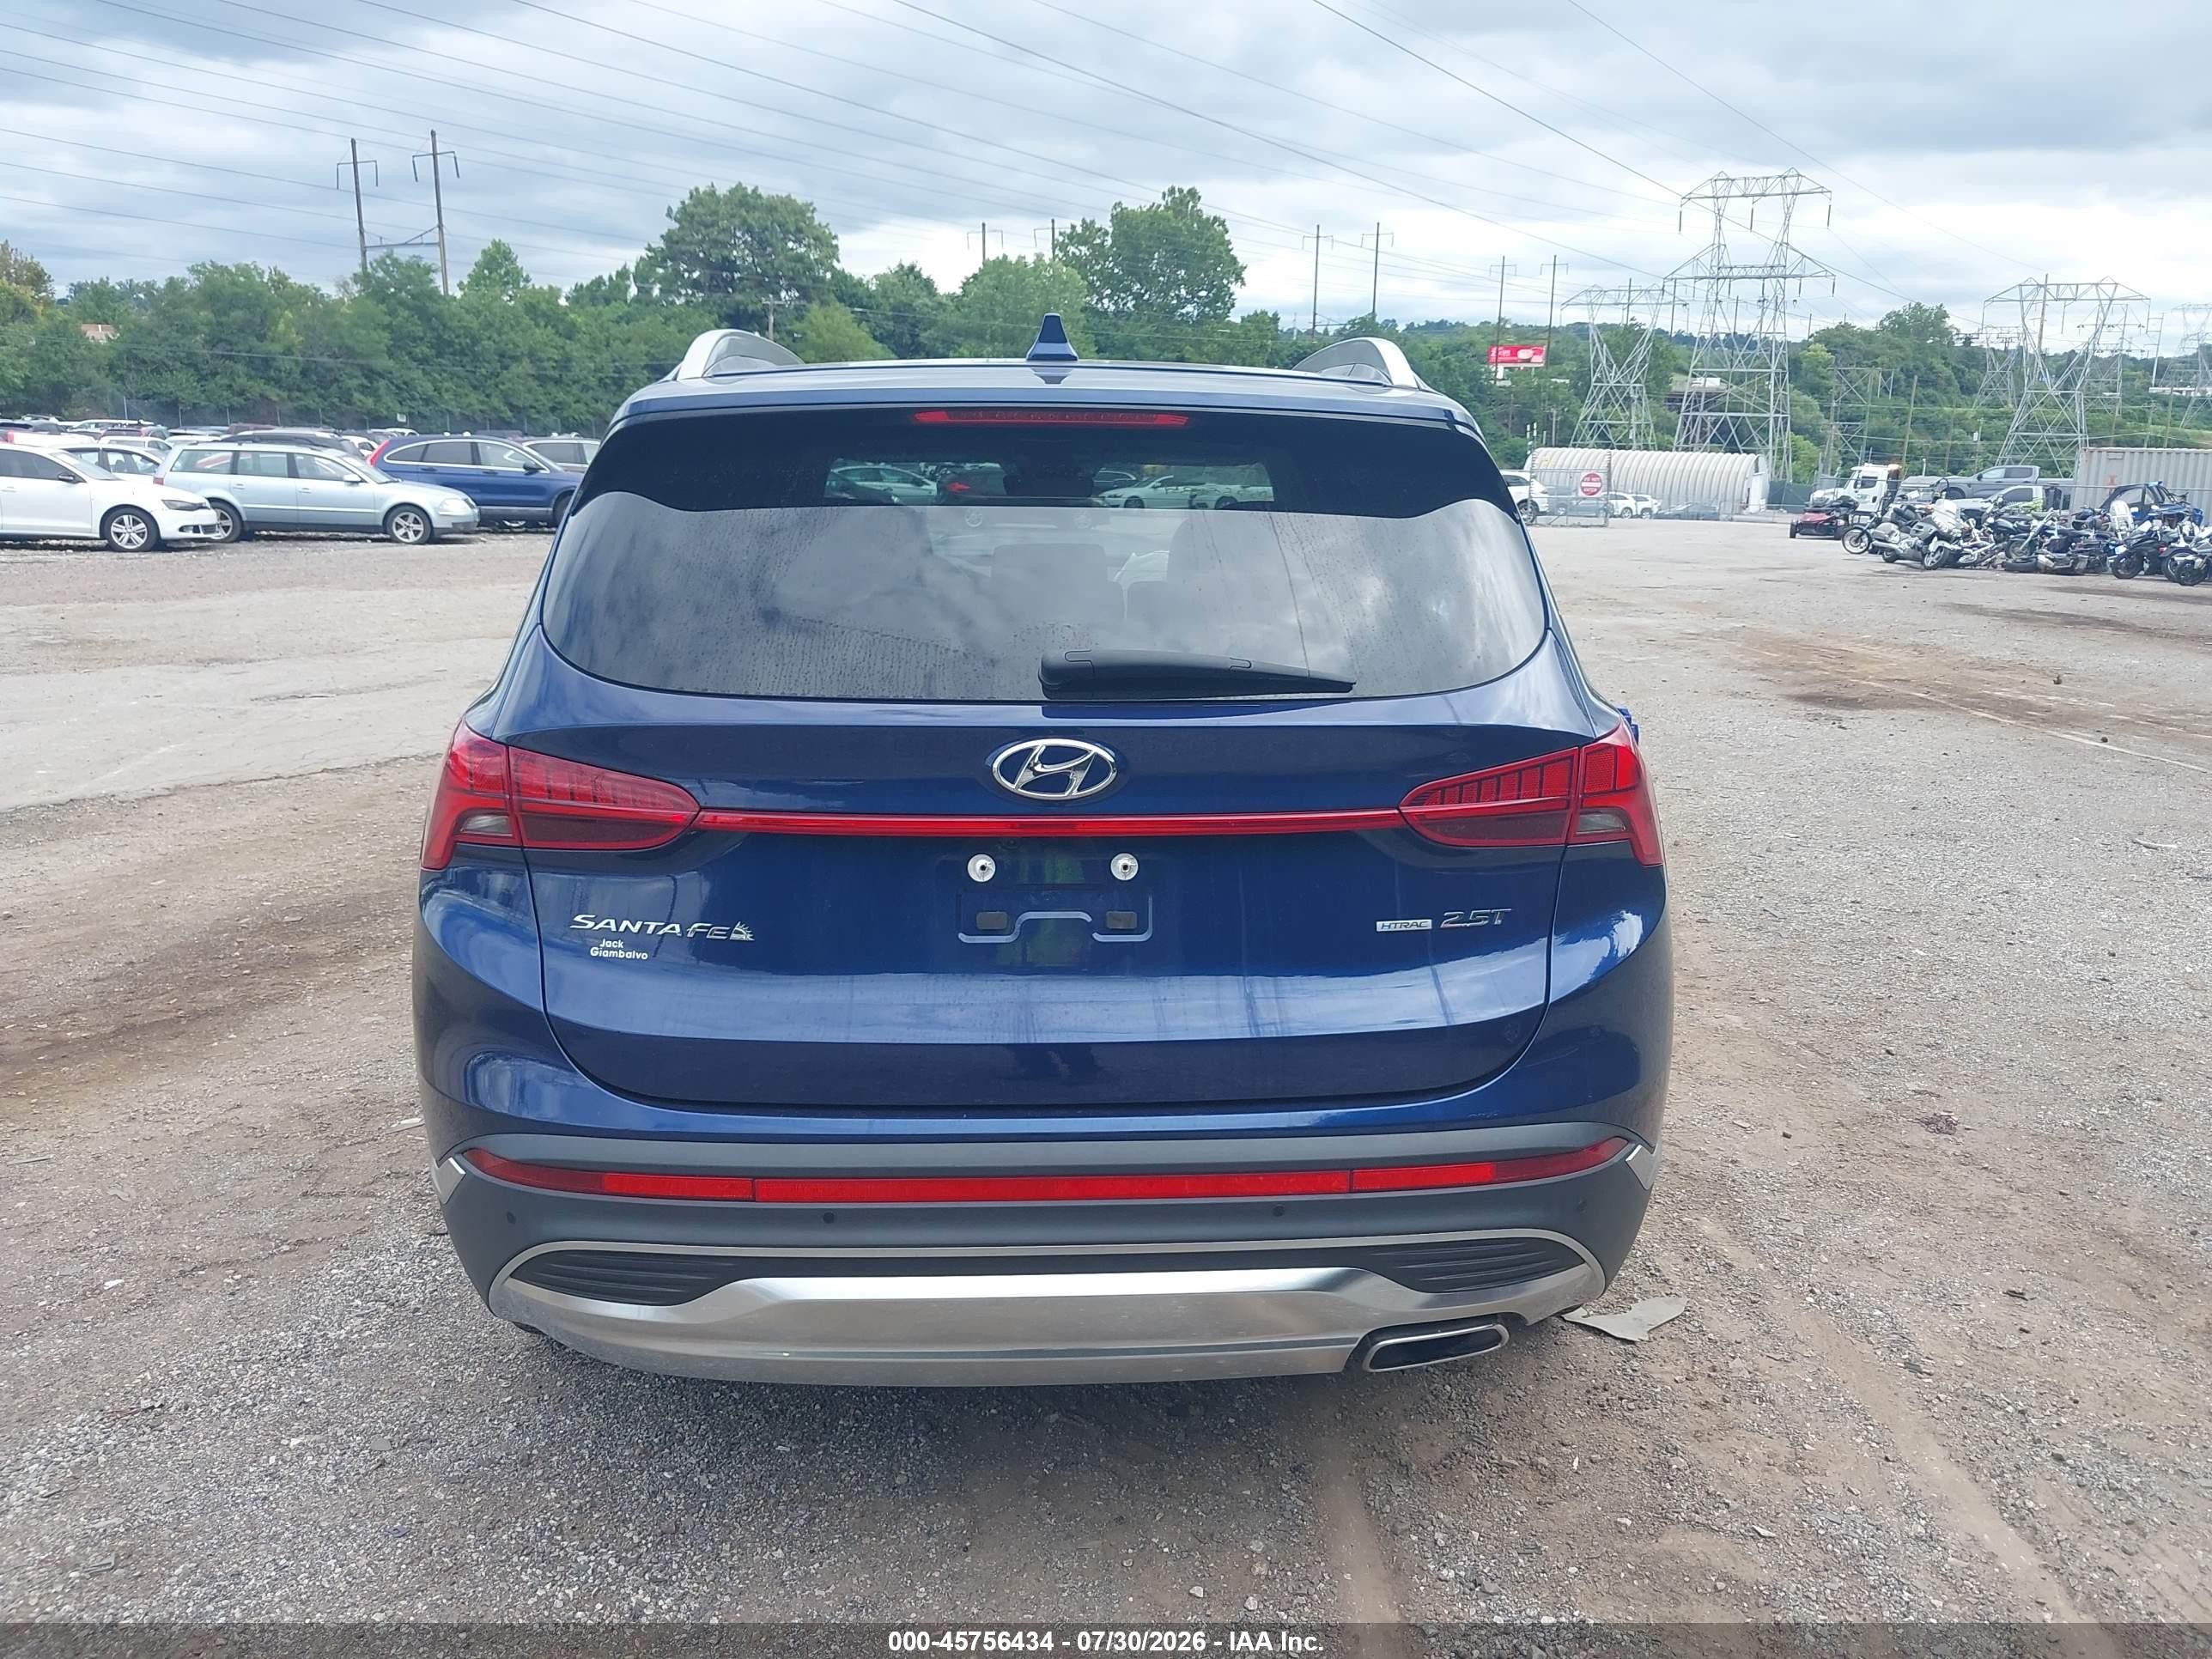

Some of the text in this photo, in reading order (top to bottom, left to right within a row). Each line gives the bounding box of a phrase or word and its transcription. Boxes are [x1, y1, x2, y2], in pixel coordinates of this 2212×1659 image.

[570, 914, 731, 939] SANTA FE
[1381, 921, 1429, 930] HTRAC
[599, 939, 624, 948] Jack
[590, 946, 648, 960] Giambalvo
